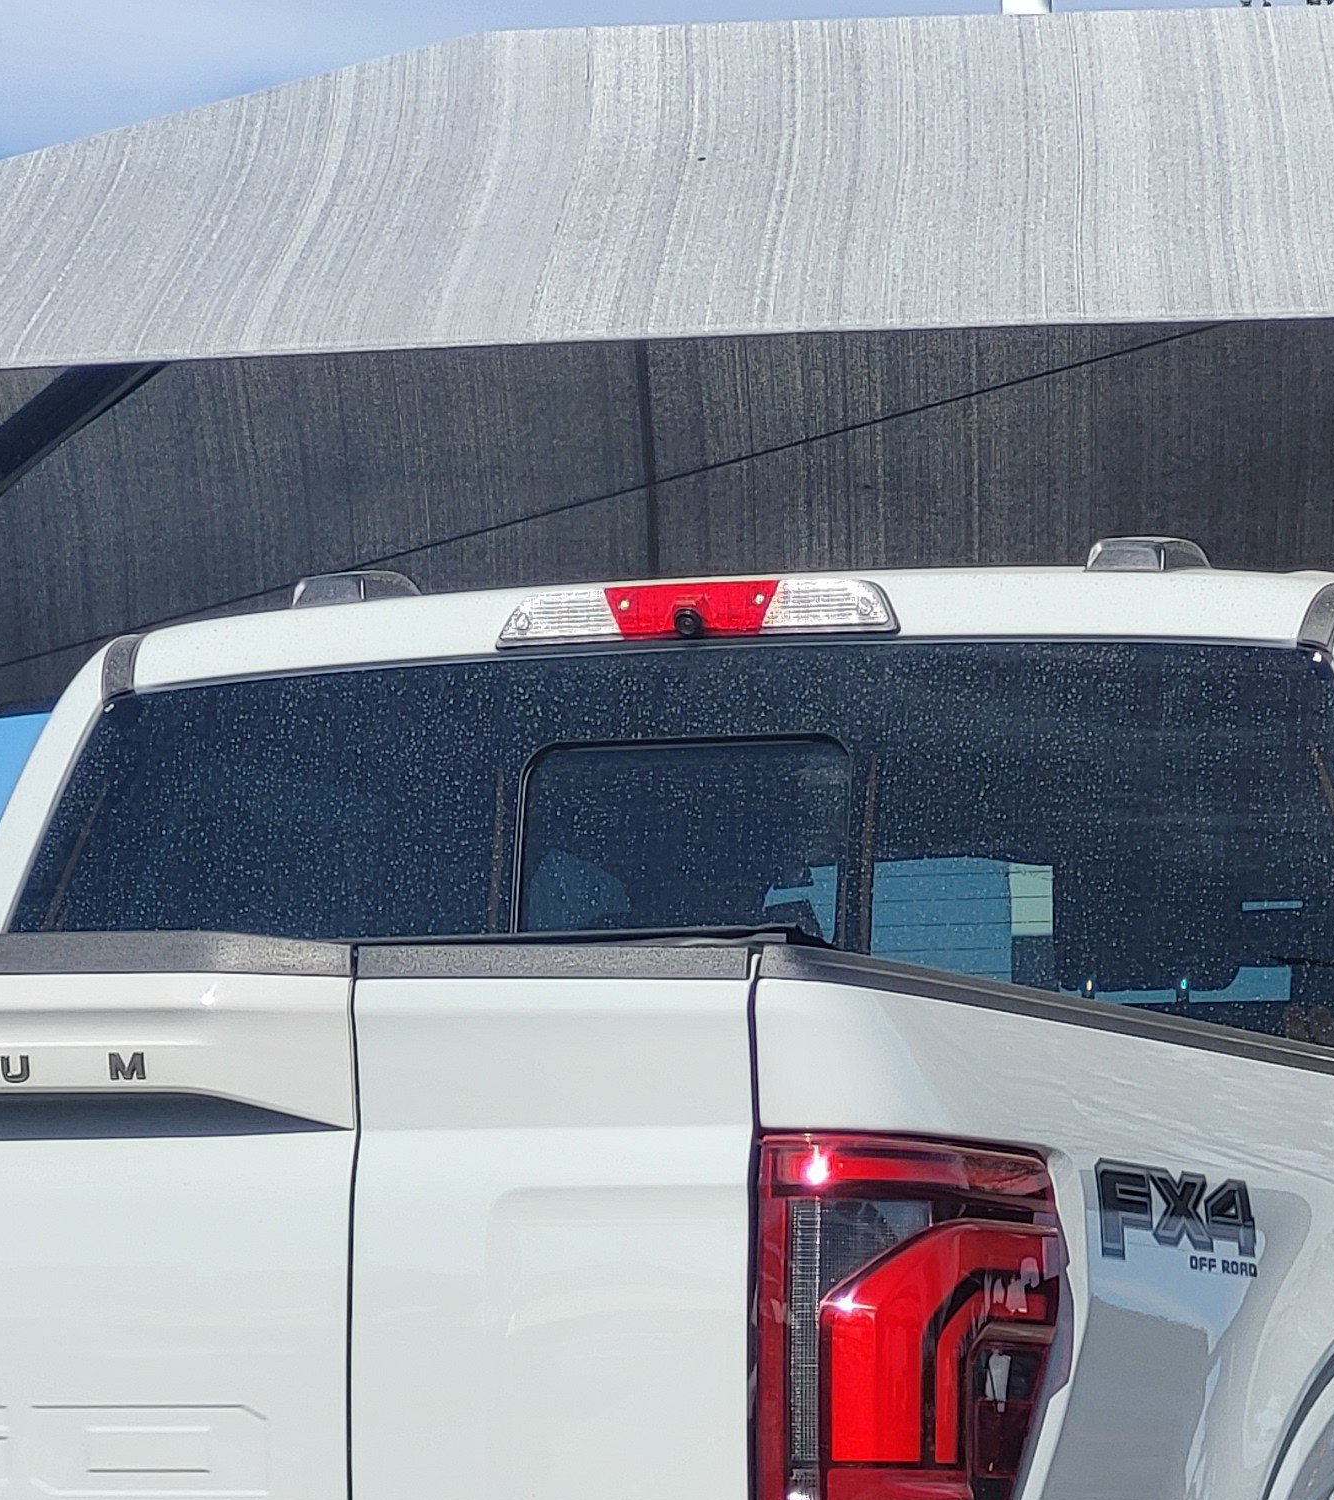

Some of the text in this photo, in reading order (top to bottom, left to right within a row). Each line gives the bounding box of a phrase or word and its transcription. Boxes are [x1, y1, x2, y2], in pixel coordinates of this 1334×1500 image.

[1094, 1157, 1257, 1260] FX4
[1189, 1256, 1258, 1277] OFF ROAD
